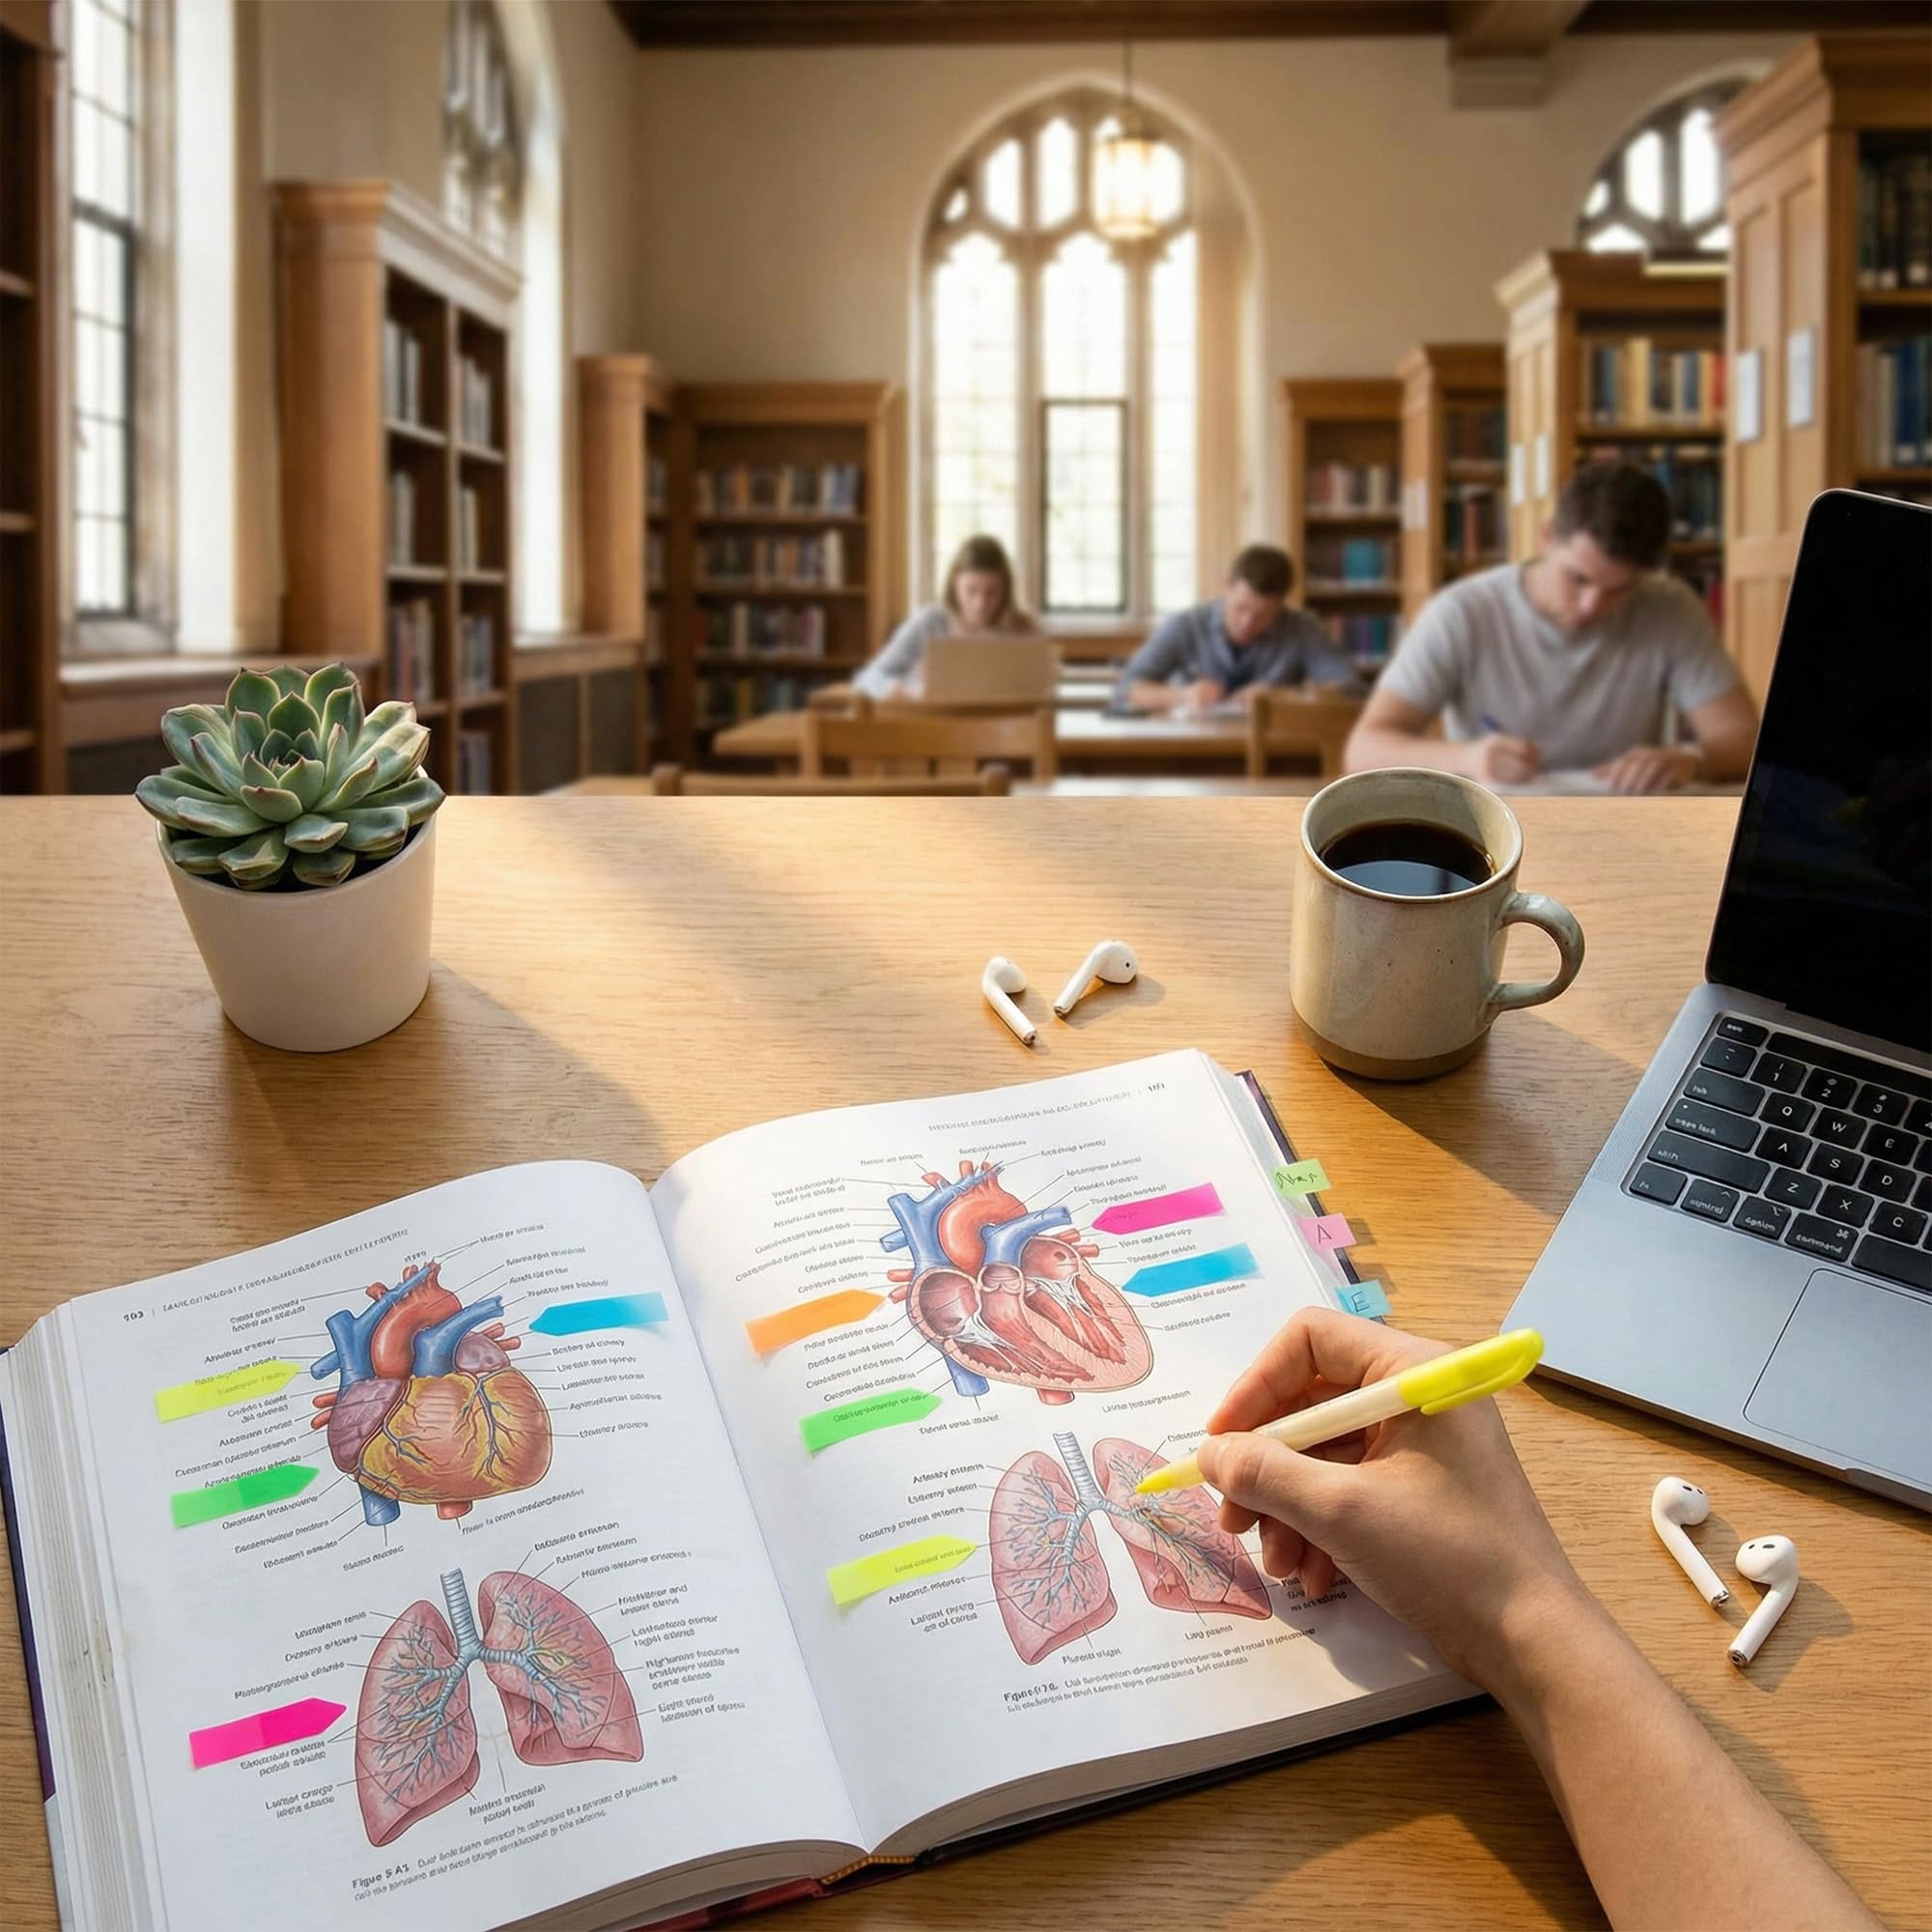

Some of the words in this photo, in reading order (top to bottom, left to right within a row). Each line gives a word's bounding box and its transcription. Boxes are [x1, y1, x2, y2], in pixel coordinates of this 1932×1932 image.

[1821, 1088, 1832, 1097] 2
[1873, 1103, 1883, 1114] 3
[1832, 1121, 1847, 1133] W
[1829, 1158, 1841, 1169] S
[1881, 1175, 1893, 1185] D
[1786, 1182, 1799, 1193] Z
[1839, 1199, 1852, 1210] X
[1892, 1216, 1904, 1228] C
[1317, 1224, 1333, 1245] A
[1350, 1291, 1370, 1314] E
